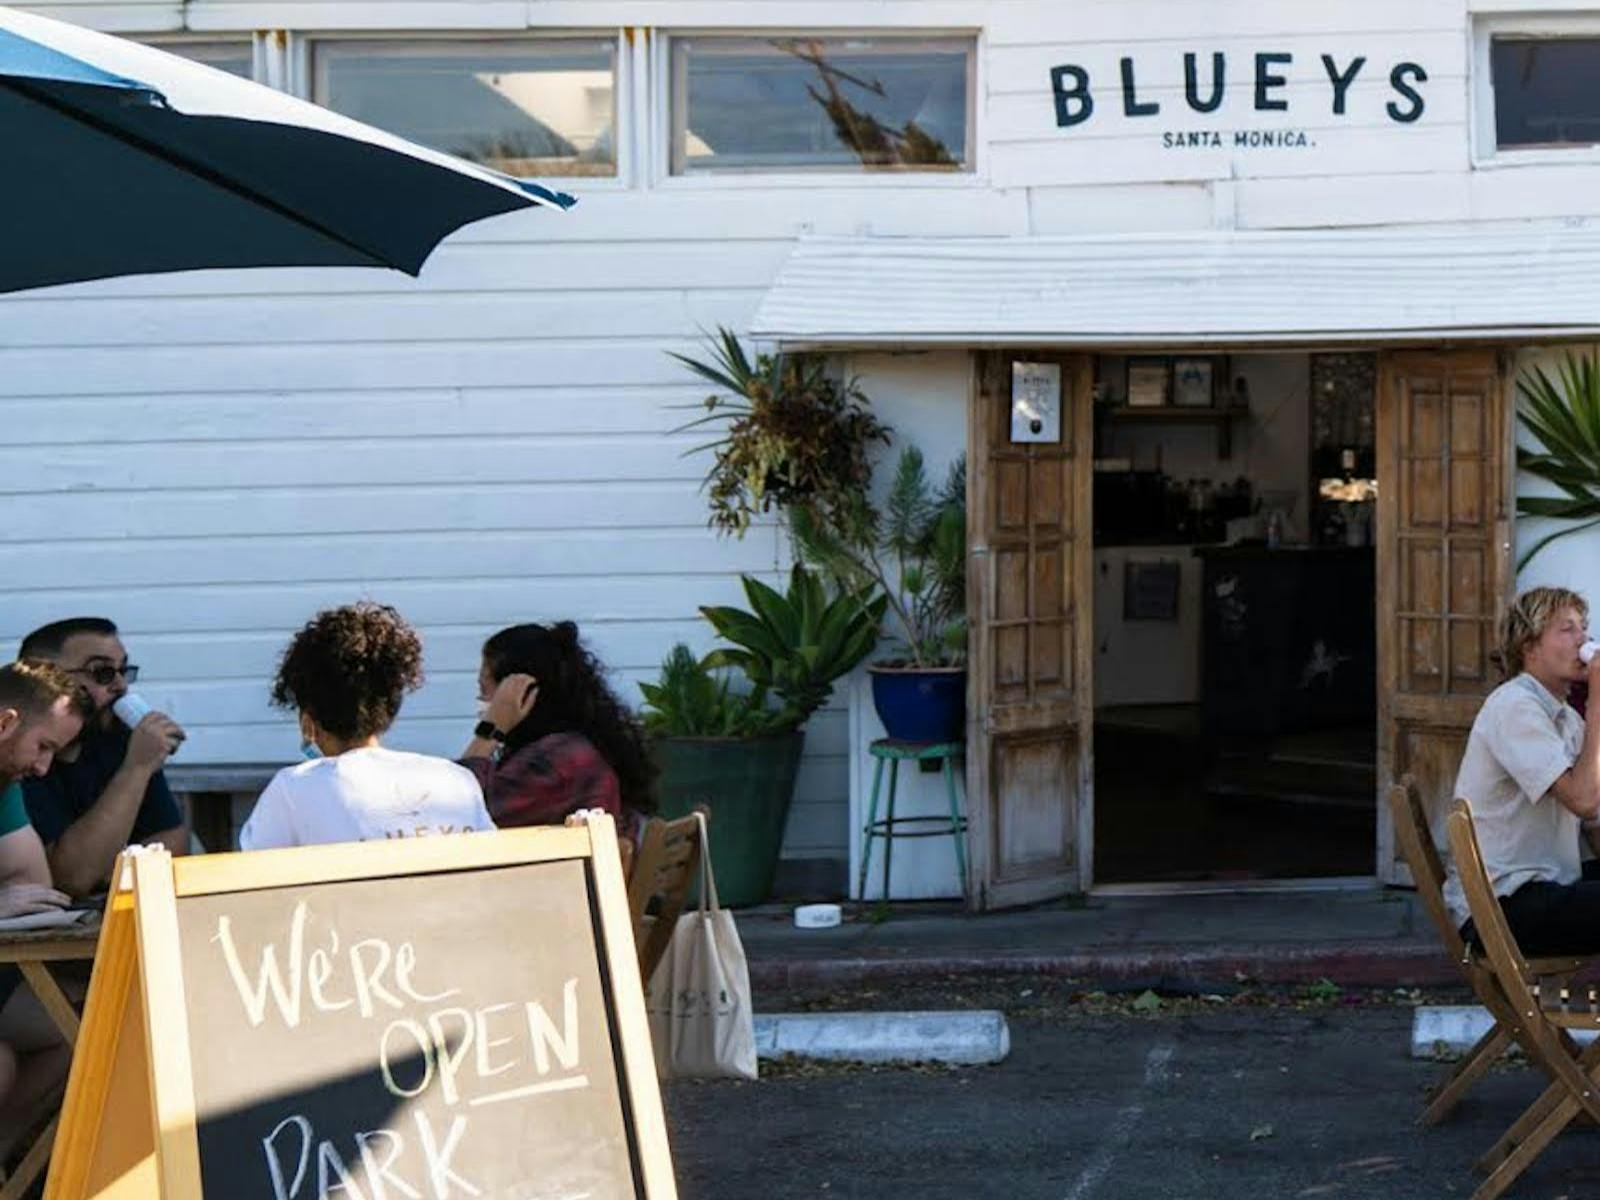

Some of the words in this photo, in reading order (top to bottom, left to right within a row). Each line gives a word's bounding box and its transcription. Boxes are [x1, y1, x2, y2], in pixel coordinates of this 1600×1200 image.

[1050, 51, 1429, 128] BLUEYS
[1162, 132, 1222, 148] SANTA
[379, 976, 580, 1106] OPEN
[263, 1109, 482, 1200] PARK
